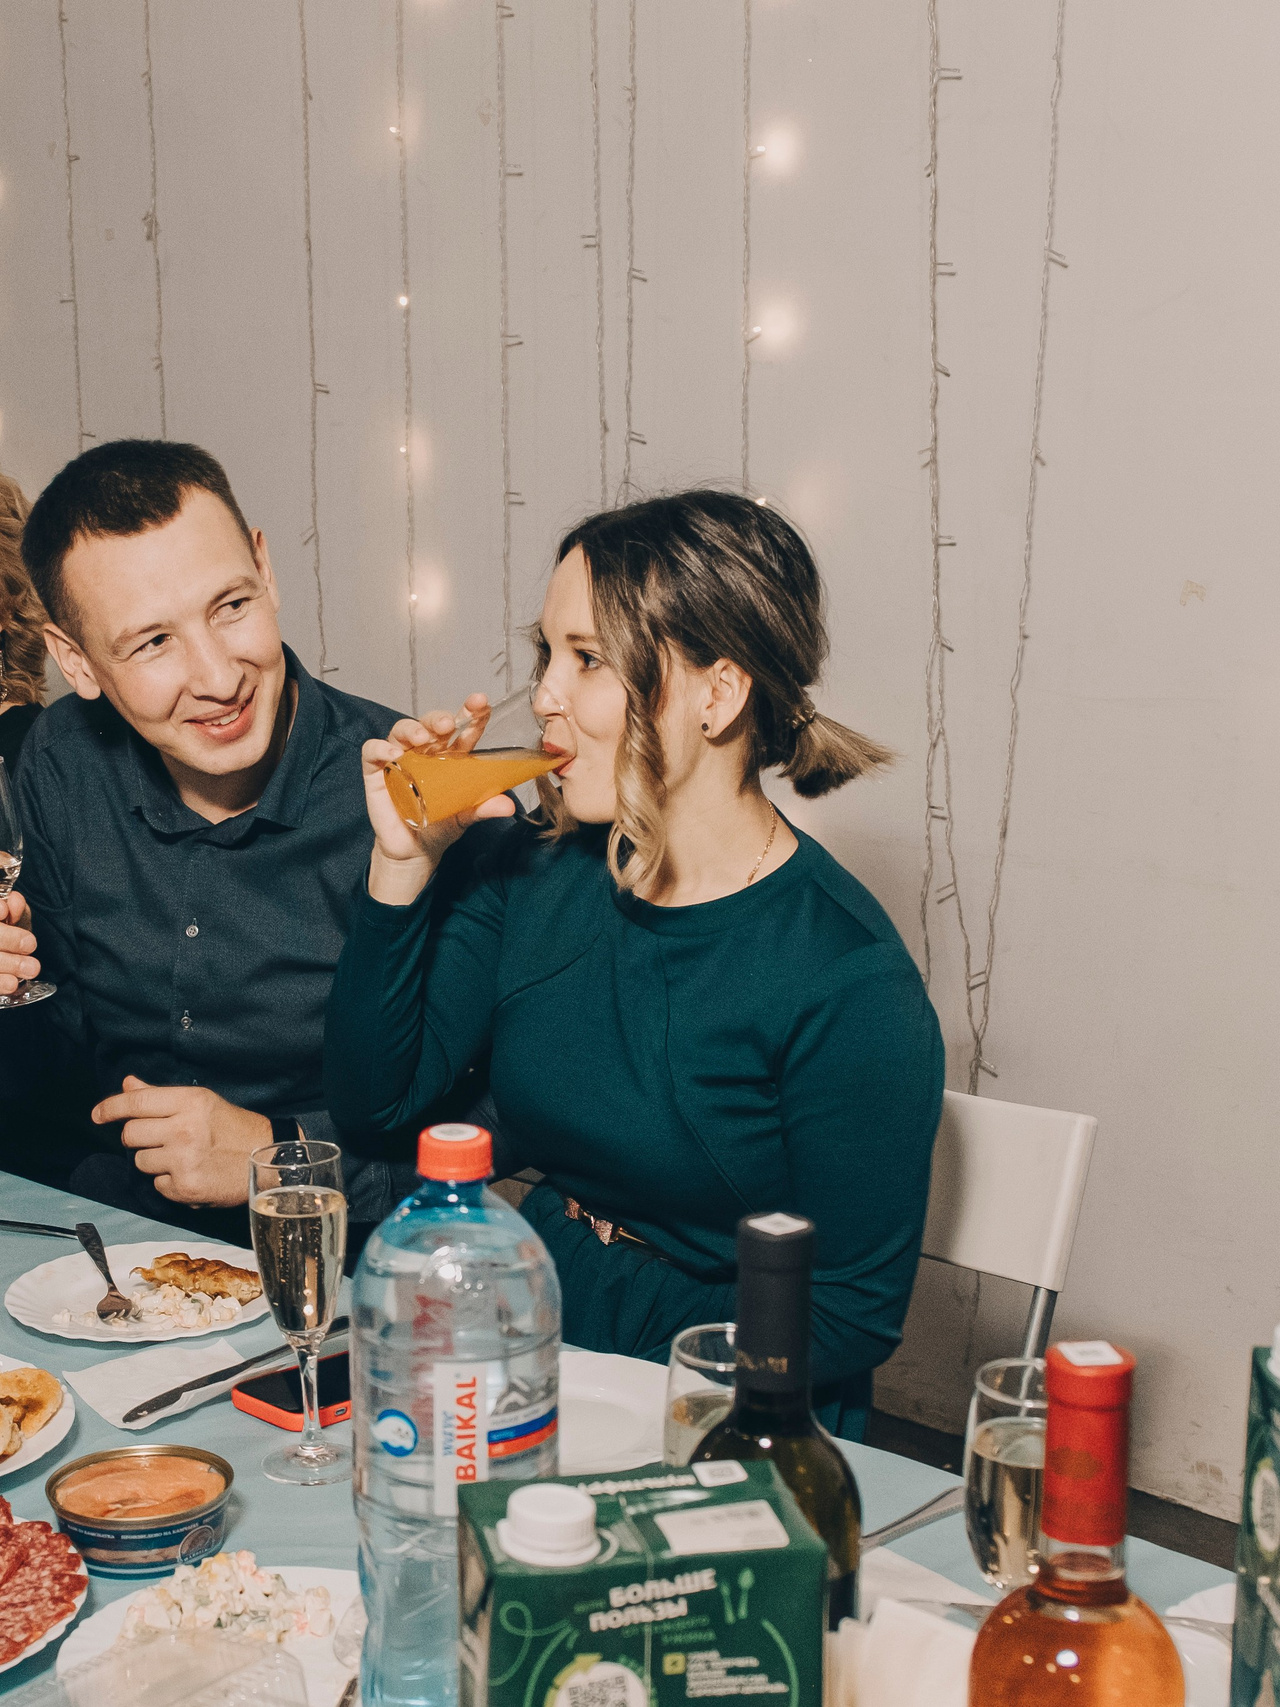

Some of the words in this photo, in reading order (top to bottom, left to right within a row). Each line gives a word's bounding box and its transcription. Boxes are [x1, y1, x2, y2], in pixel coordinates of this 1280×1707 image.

[455, 1376, 476, 1481] BAIKAL
[608, 1567, 718, 1608] БОЛЬШЕ
[588, 1596, 689, 1633] ПОЛЬЗЫ
